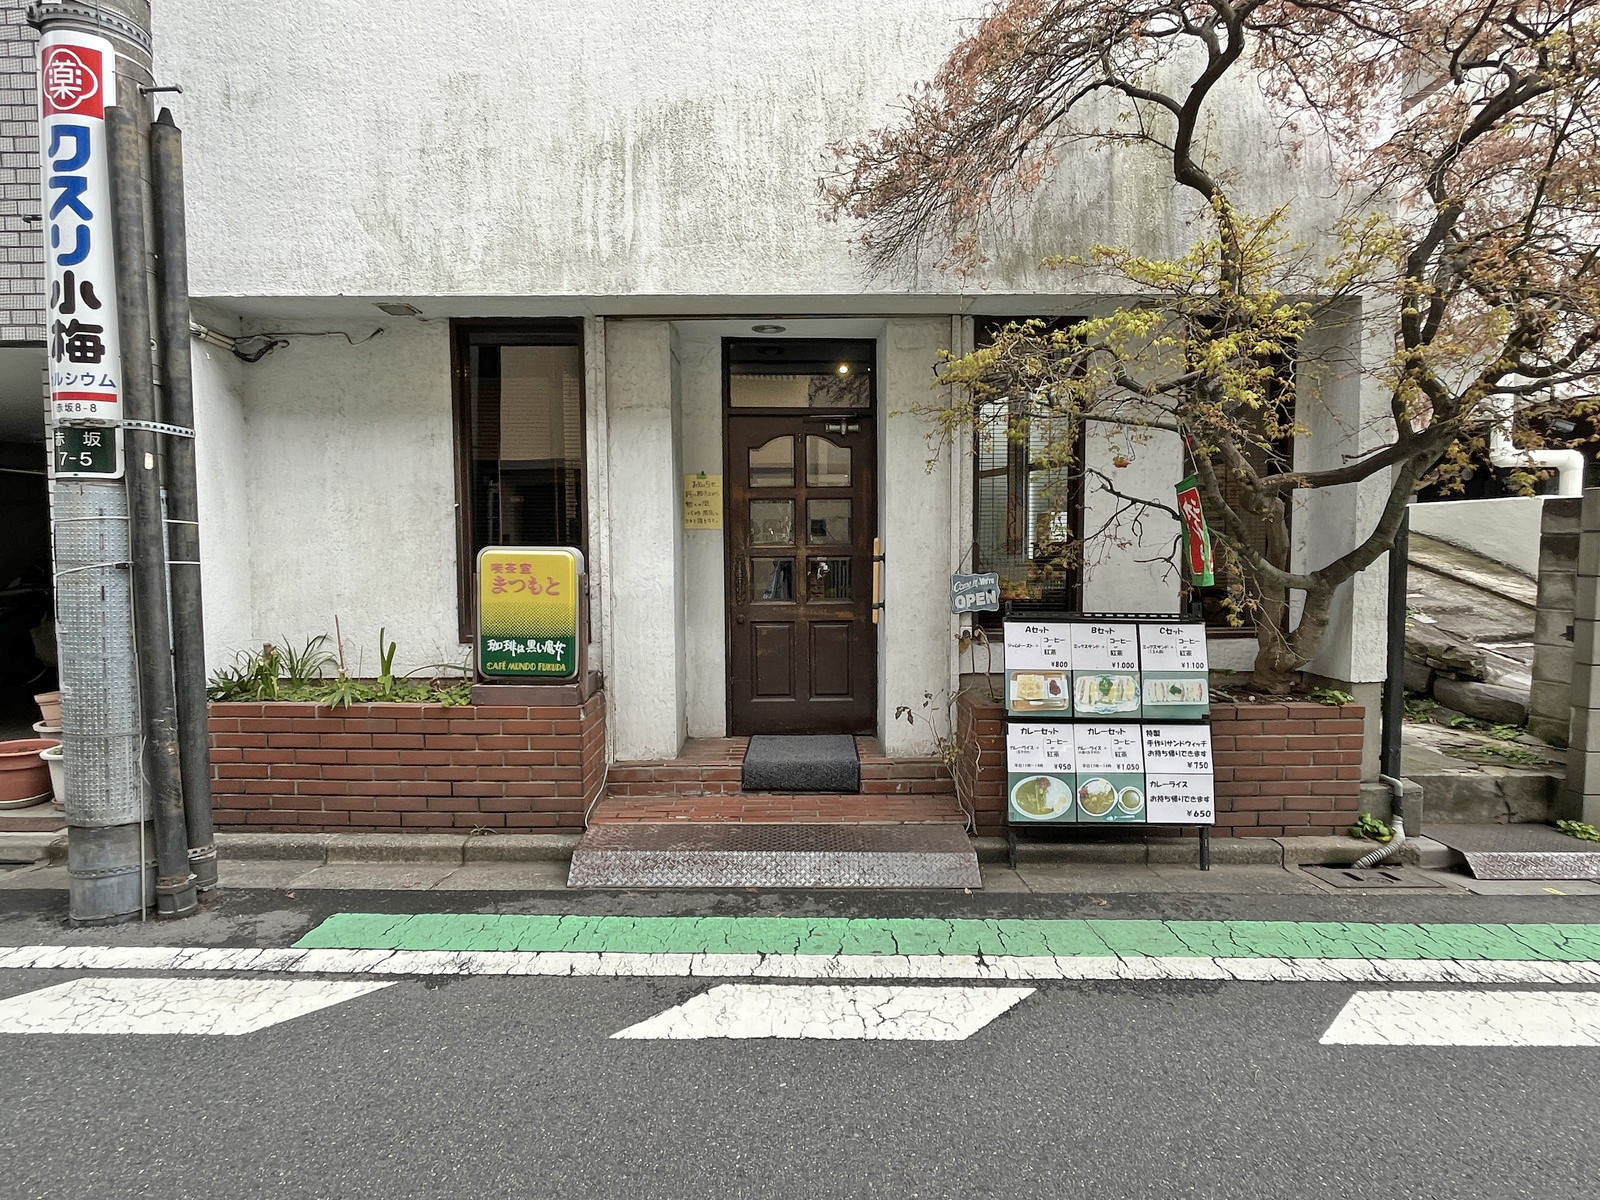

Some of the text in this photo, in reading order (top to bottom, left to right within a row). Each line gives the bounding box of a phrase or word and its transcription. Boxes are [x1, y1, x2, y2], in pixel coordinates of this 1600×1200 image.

[52, 372, 117, 388] ルシウム
[59, 452, 92, 467] 7-5
[491, 563, 532, 574] 喫茶室
[492, 575, 560, 596] まつもと
[955, 590, 996, 608] OPEN
[1025, 626, 1050, 634] Aセット
[1091, 626, 1116, 635] Bセット
[1159, 627, 1184, 635] Cセット
[487, 639, 566, 661] 珈琲は黒い魔女
[508, 663, 536, 671] MUNDO
[538, 663, 566, 671] FUKUDA
[1020, 727, 1059, 736] カレーセット
[1087, 727, 1126, 736] カレーセット
[1146, 729, 1160, 737] 特製
[1147, 739, 1207, 747] 手作りサンドウィッチ
[1147, 749, 1207, 758] お持ち帰りできます
[1054, 763, 1072, 771] ¥950
[1187, 761, 1209, 769] ¥750
[1149, 780, 1188, 788] カレーライス
[1149, 795, 1210, 803] お持ち帰りできます
[1186, 809, 1211, 818] ¥650
